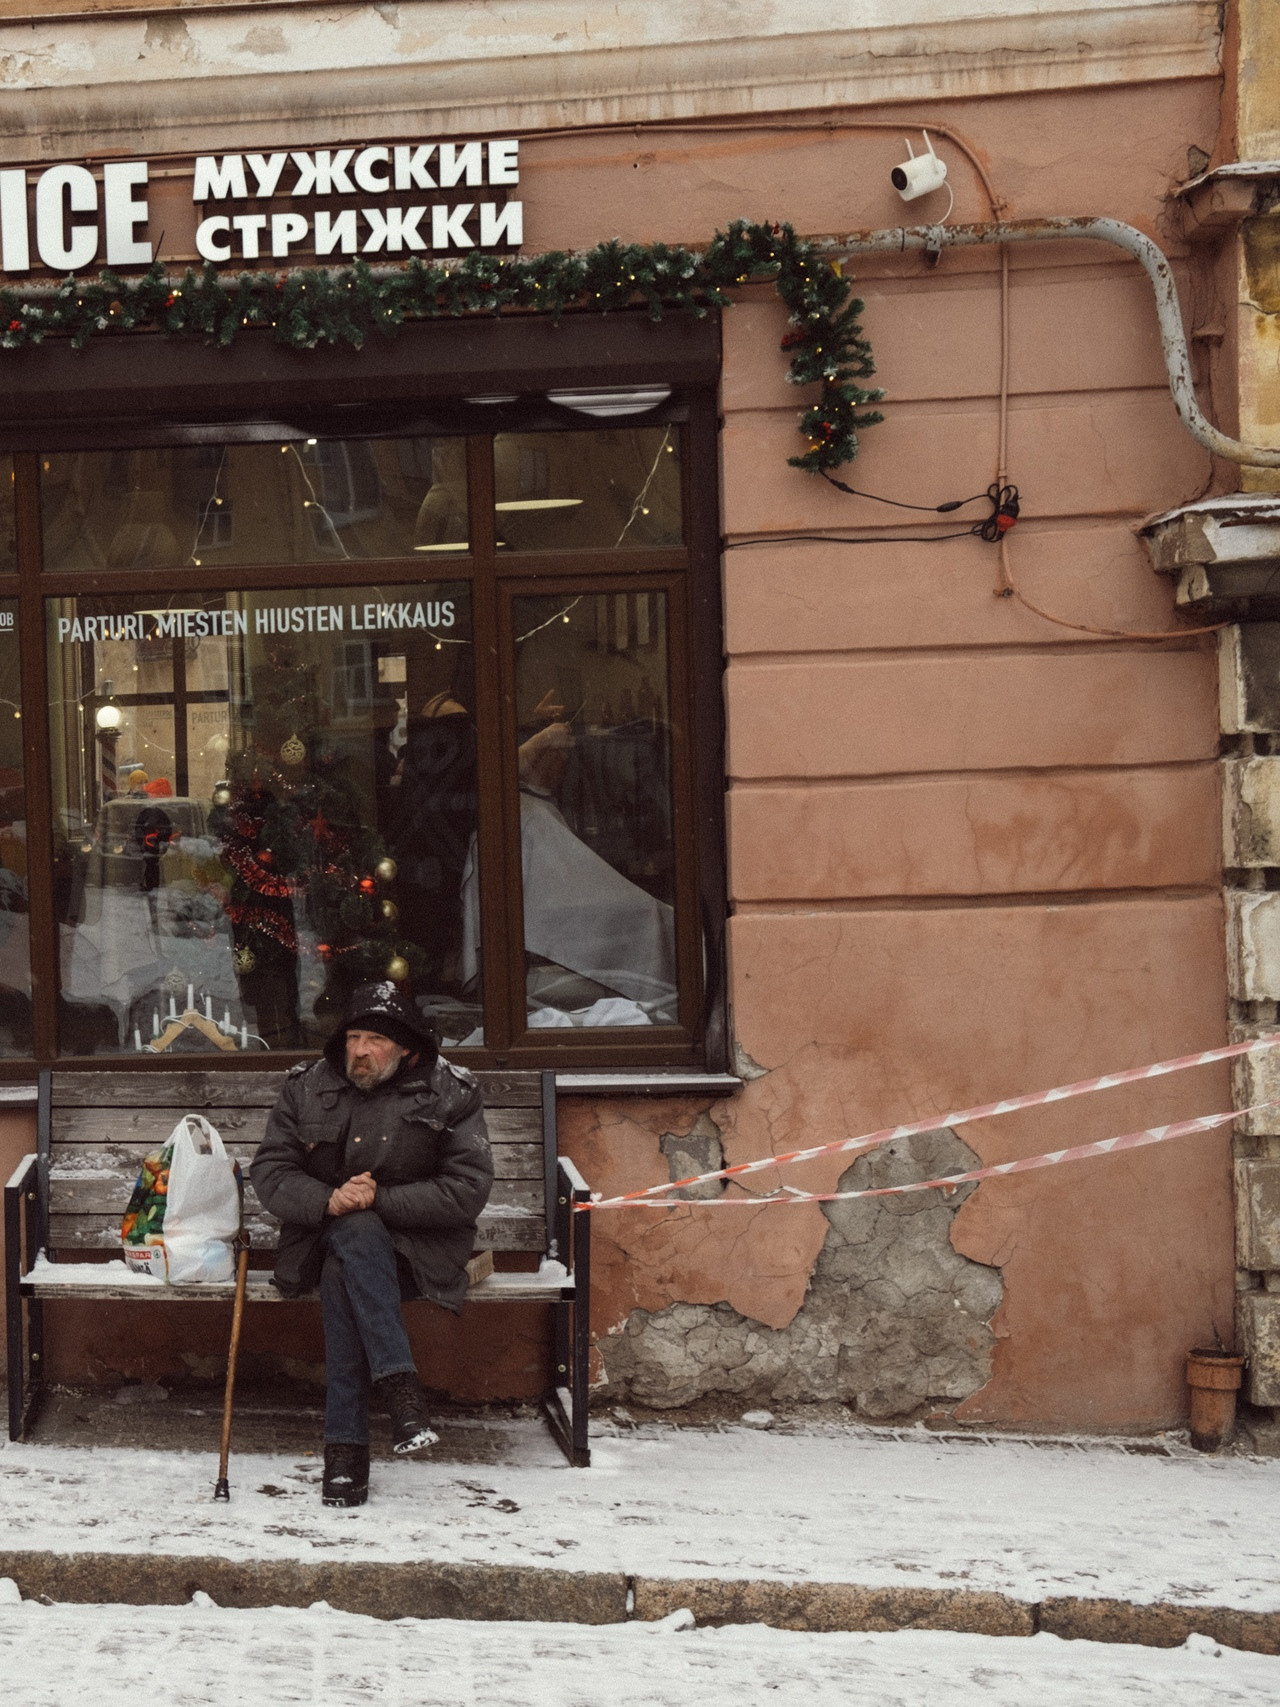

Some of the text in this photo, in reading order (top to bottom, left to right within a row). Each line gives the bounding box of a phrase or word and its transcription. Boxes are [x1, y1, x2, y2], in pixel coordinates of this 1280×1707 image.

[193, 139, 520, 202] МУЖСКИЕ
[195, 199, 524, 262] СТРИЖКИ
[157, 609, 248, 639] MIESTEN
[255, 605, 343, 634] HIUSTEN
[351, 601, 455, 630] LEIKKAUS
